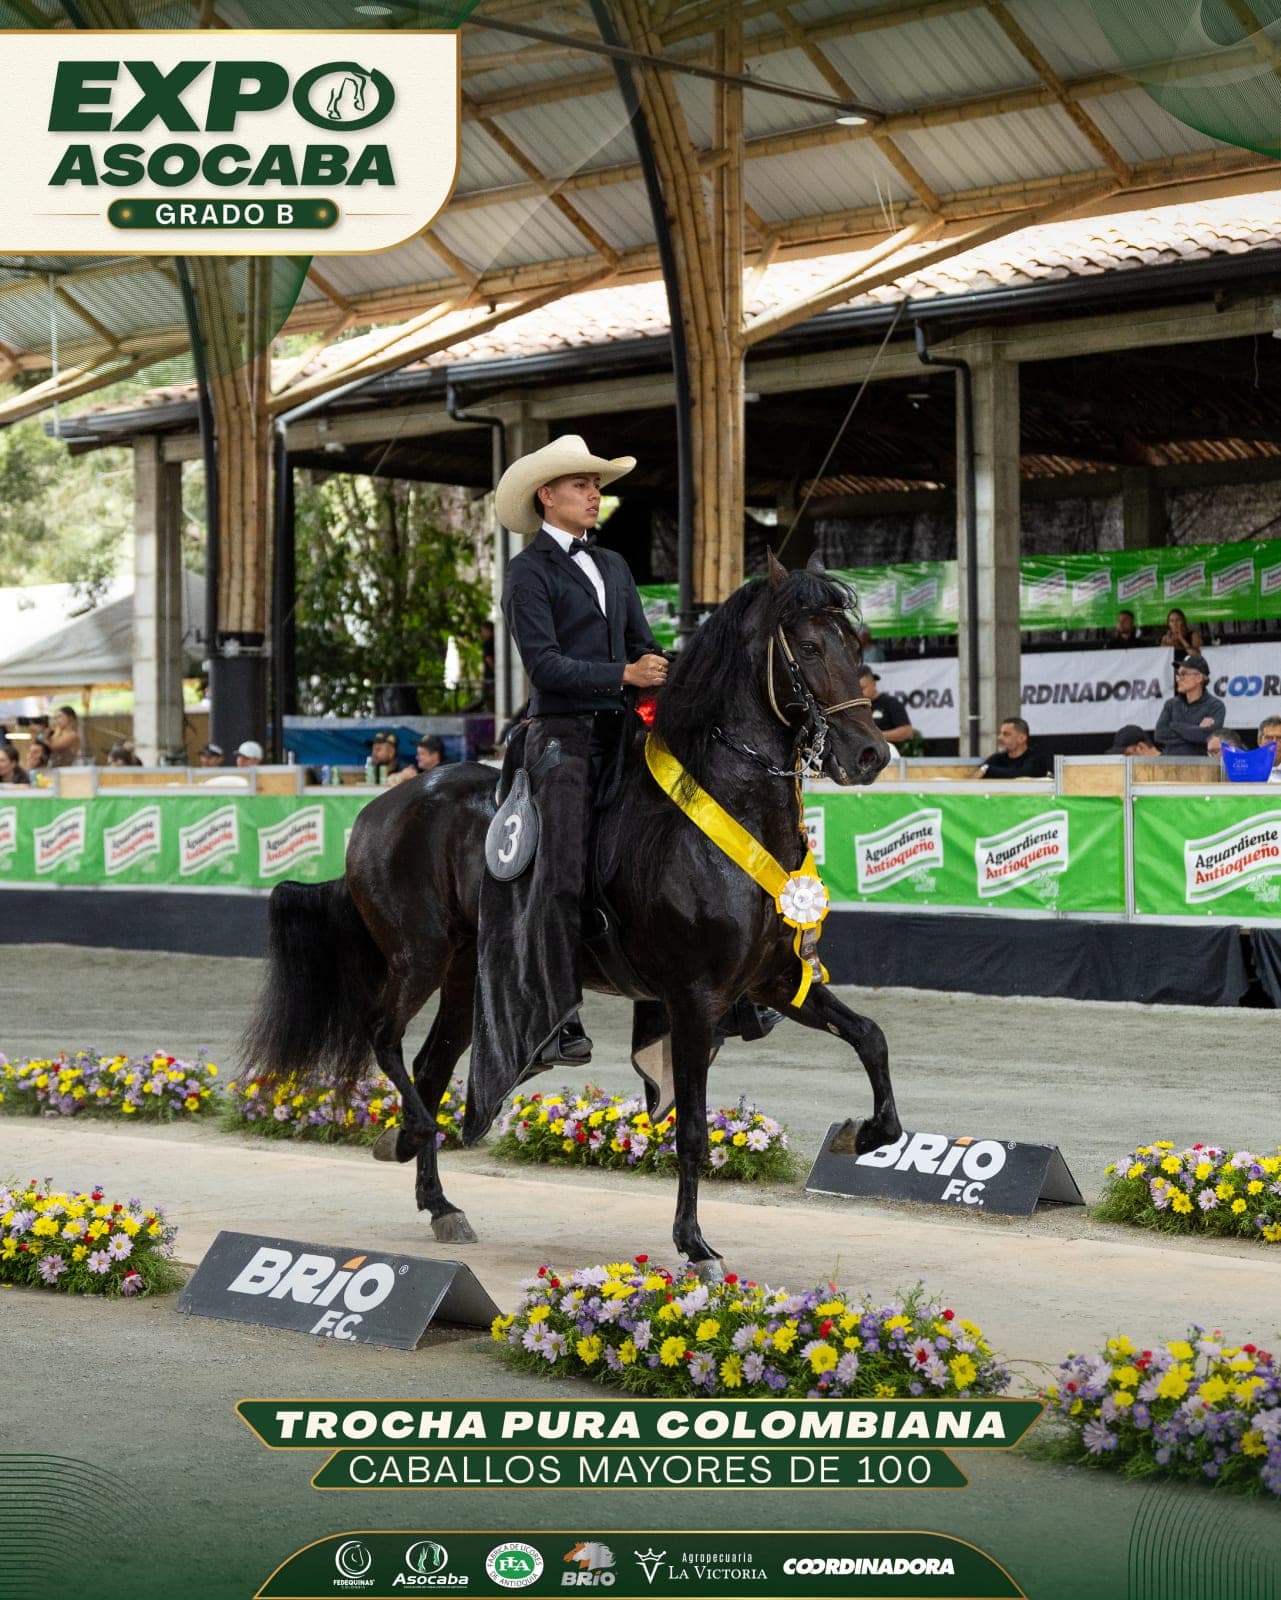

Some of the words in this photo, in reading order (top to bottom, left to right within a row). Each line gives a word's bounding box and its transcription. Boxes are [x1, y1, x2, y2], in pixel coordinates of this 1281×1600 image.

[1020, 678, 1163, 705] RDINADORA
[1213, 674, 1281, 698] COOR
[497, 814, 522, 863] 3
[865, 826, 933, 862] Aguardiente
[865, 838, 935, 877] Antioqueño
[985, 828, 1059, 866] Aguardiente
[1195, 829, 1279, 870] Aguardiente
[985, 841, 1060, 880] Antioqueño
[1195, 842, 1280, 885] Antioqueño
[940, 1179, 986, 1206] F.C.
[309, 1310, 360, 1341] F.C.
